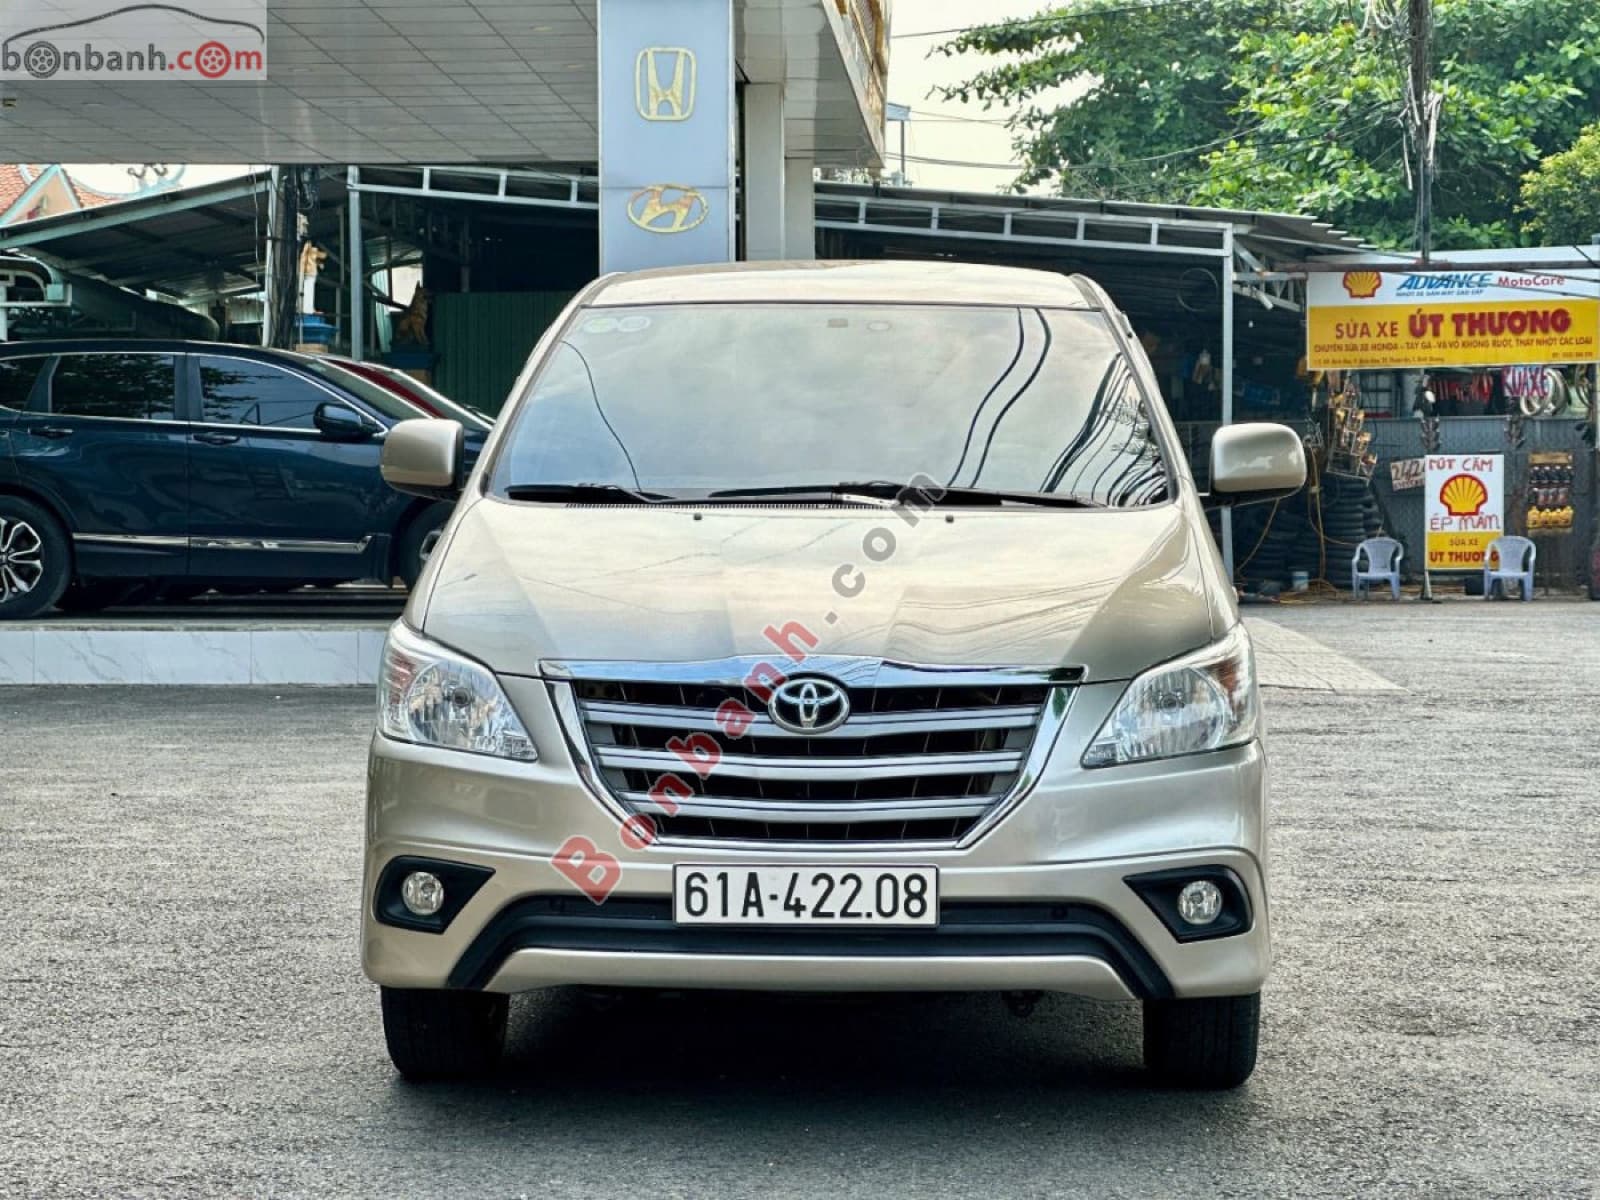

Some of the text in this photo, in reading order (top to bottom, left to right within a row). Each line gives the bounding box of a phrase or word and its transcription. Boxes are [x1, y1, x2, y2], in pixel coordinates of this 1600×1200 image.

[1396, 272, 1565, 290] ADVANCE MotoCare
[1335, 307, 1572, 339] SỬA XE ÚT THƯƠNG
[683, 871, 929, 919] 61A-422.08
